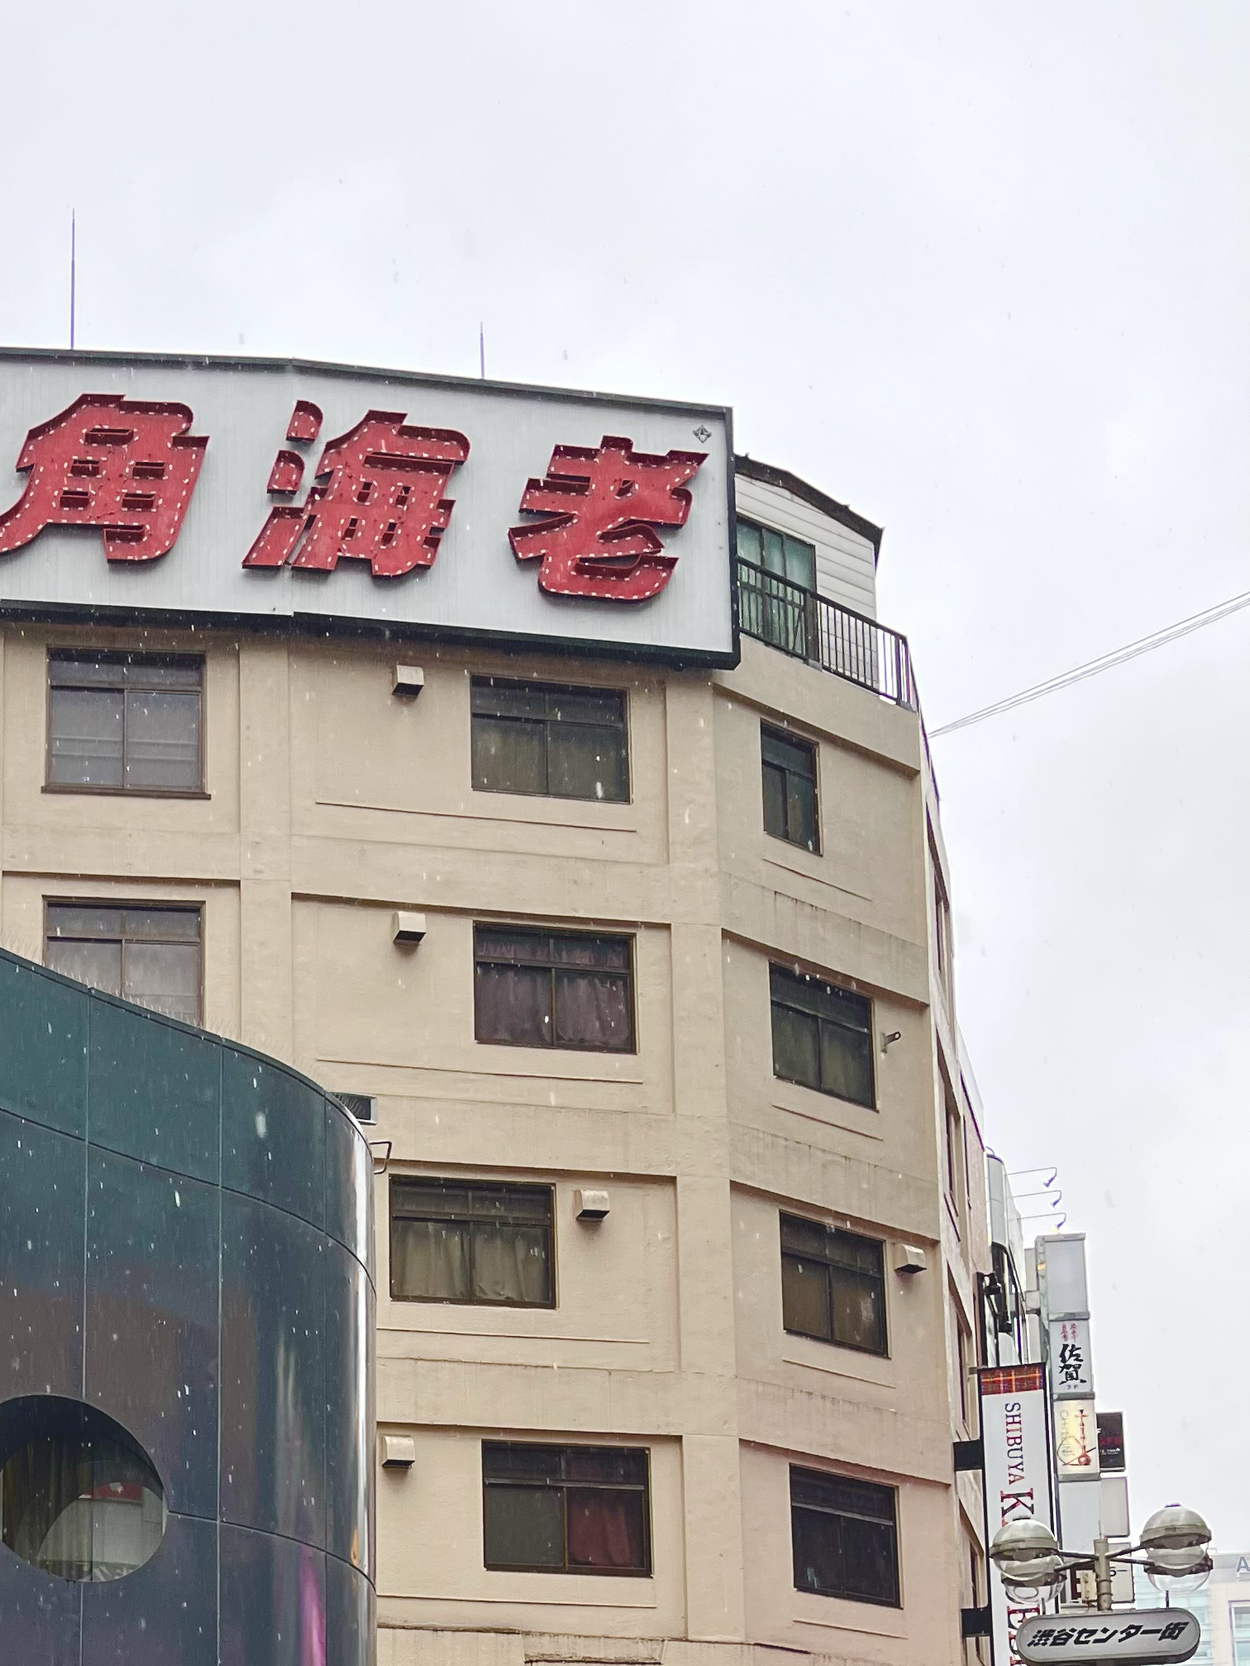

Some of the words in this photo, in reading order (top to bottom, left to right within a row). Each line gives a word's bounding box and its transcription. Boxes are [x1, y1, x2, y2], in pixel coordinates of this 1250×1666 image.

[1004, 1402, 1026, 1485] SHIBUYA
[1027, 1621, 1188, 1650] 渋谷センター街
